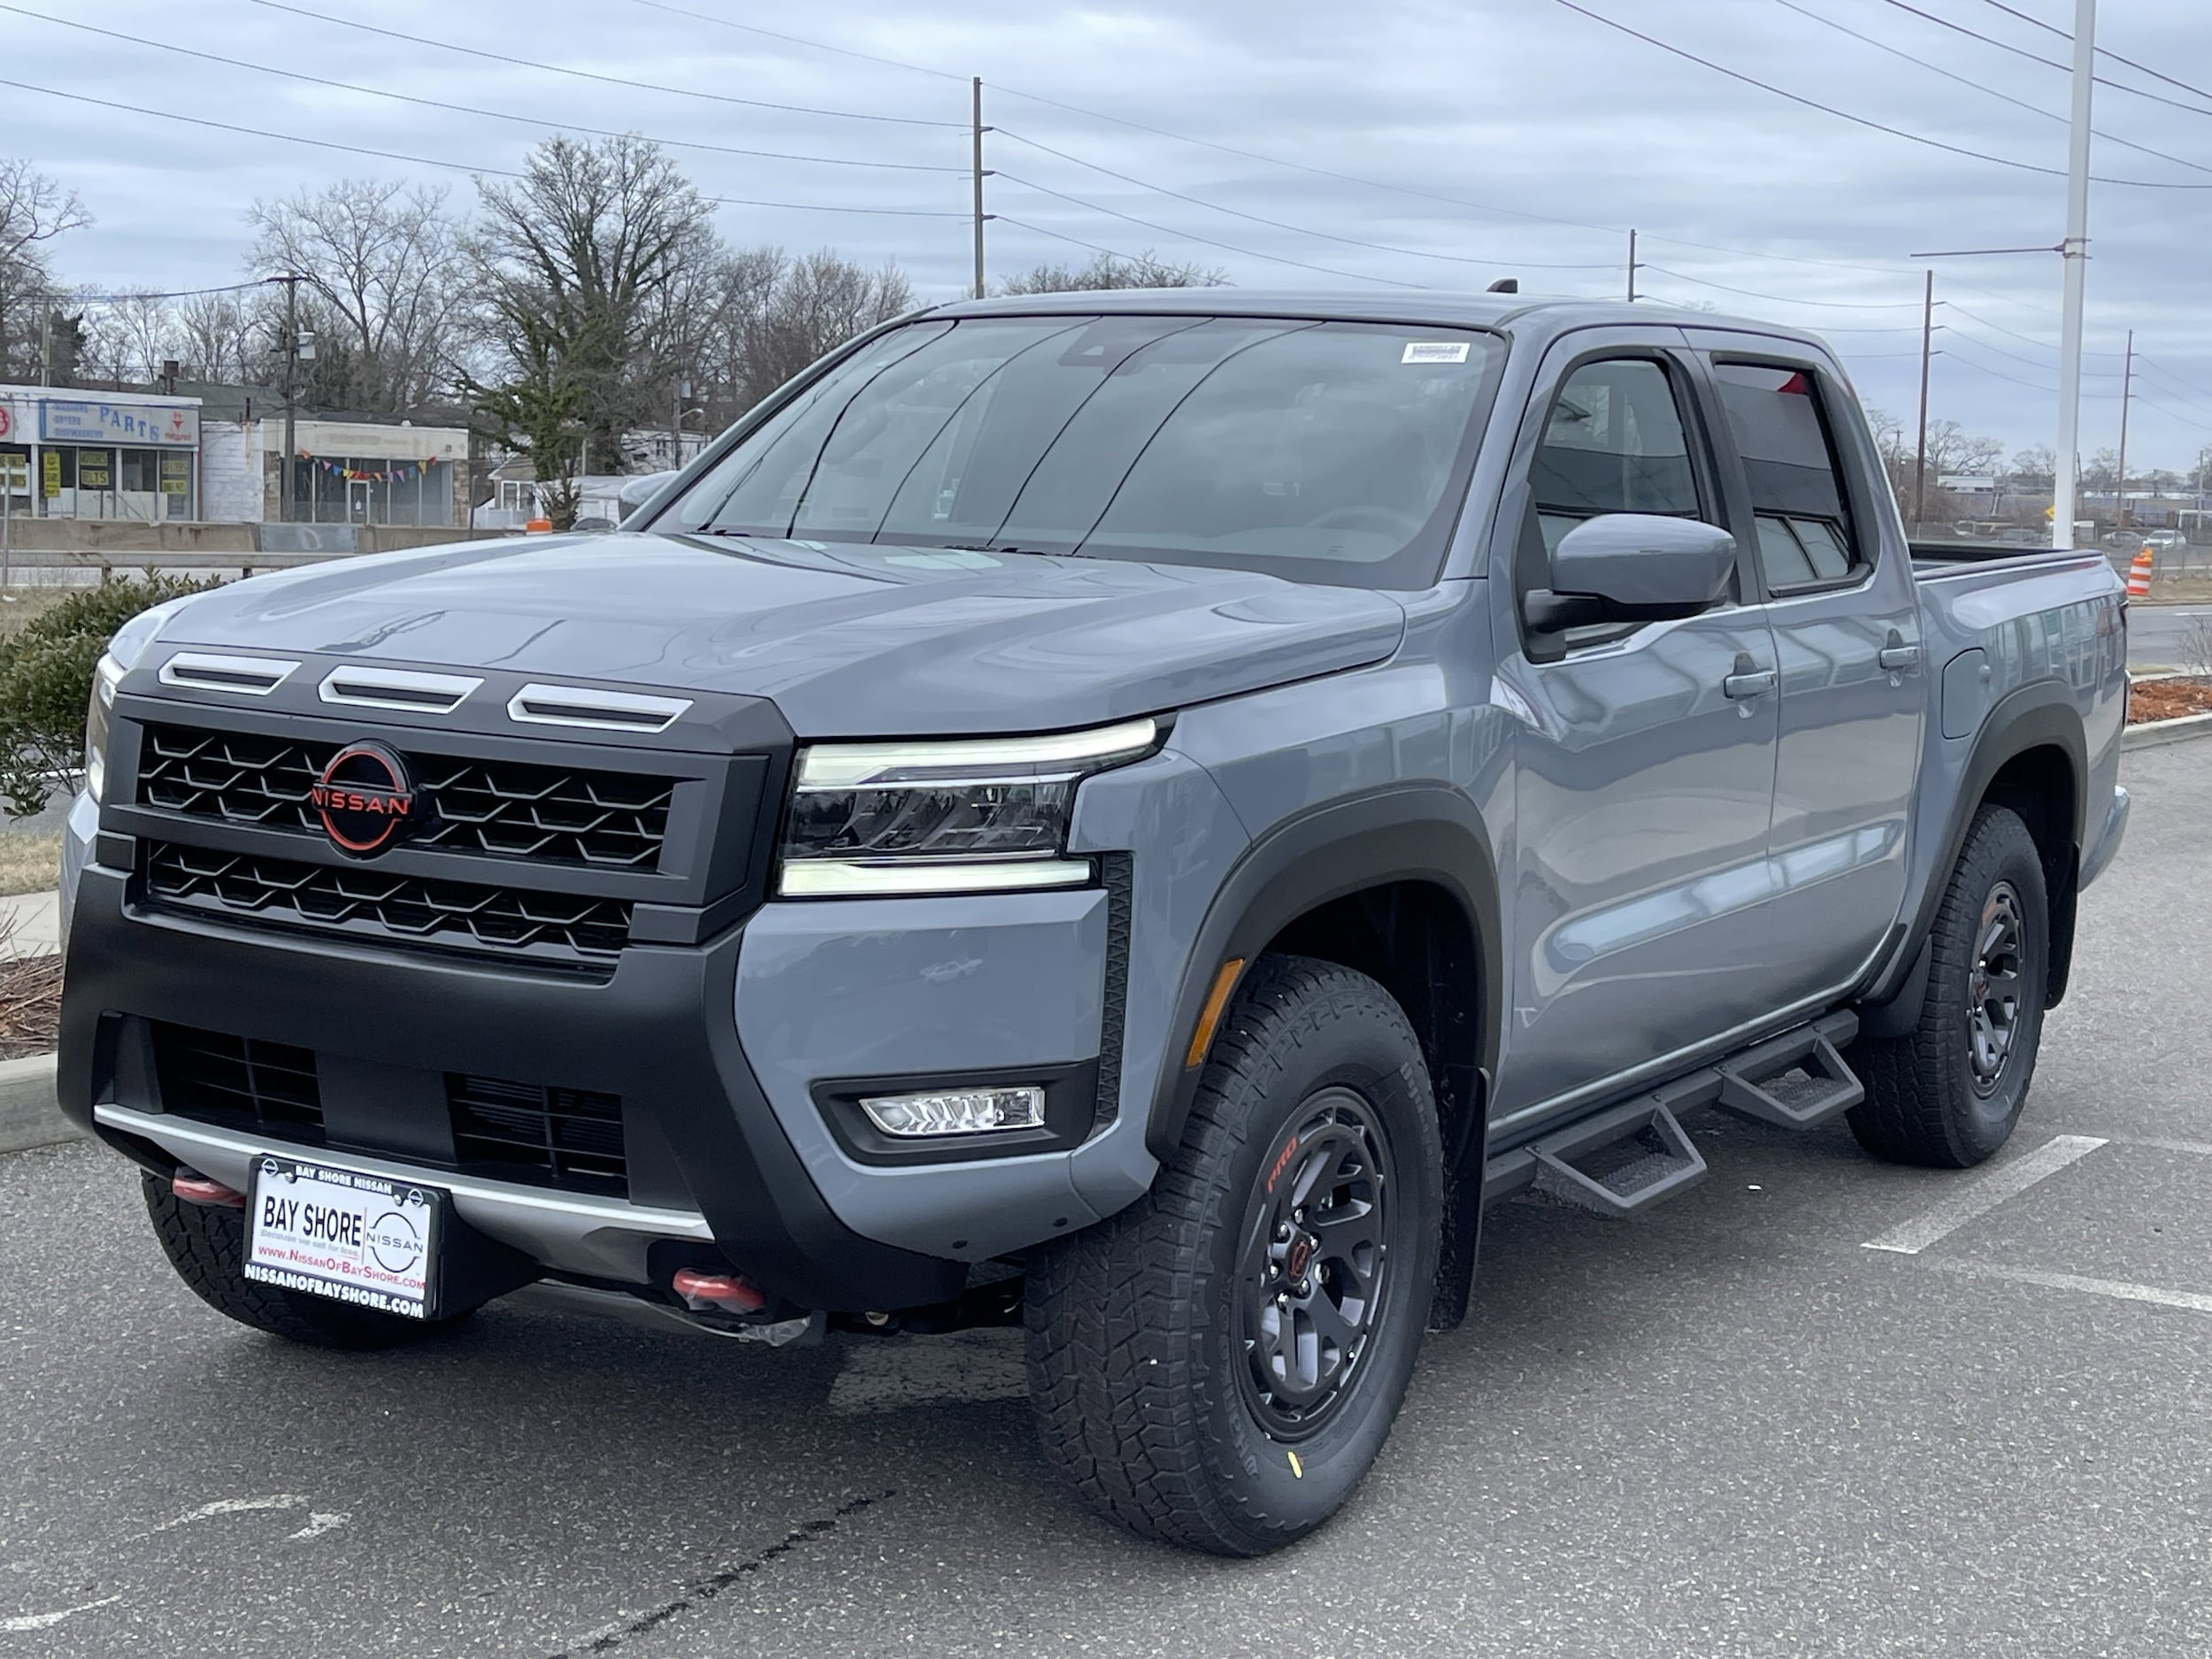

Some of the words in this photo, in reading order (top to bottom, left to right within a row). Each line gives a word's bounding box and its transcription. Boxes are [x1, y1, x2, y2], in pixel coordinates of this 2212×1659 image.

[98, 406, 159, 441] PARTS
[311, 787, 408, 815] NISSAN
[296, 1164, 316, 1179] BAY
[318, 1170, 352, 1187] SHORE
[354, 1177, 392, 1194] NISSAN
[264, 1195, 299, 1233] BAY
[303, 1203, 362, 1247] SHORE
[366, 1232, 423, 1253] NISSAN
[244, 1263, 424, 1318] NISSANOFBAYSHORE.COM
